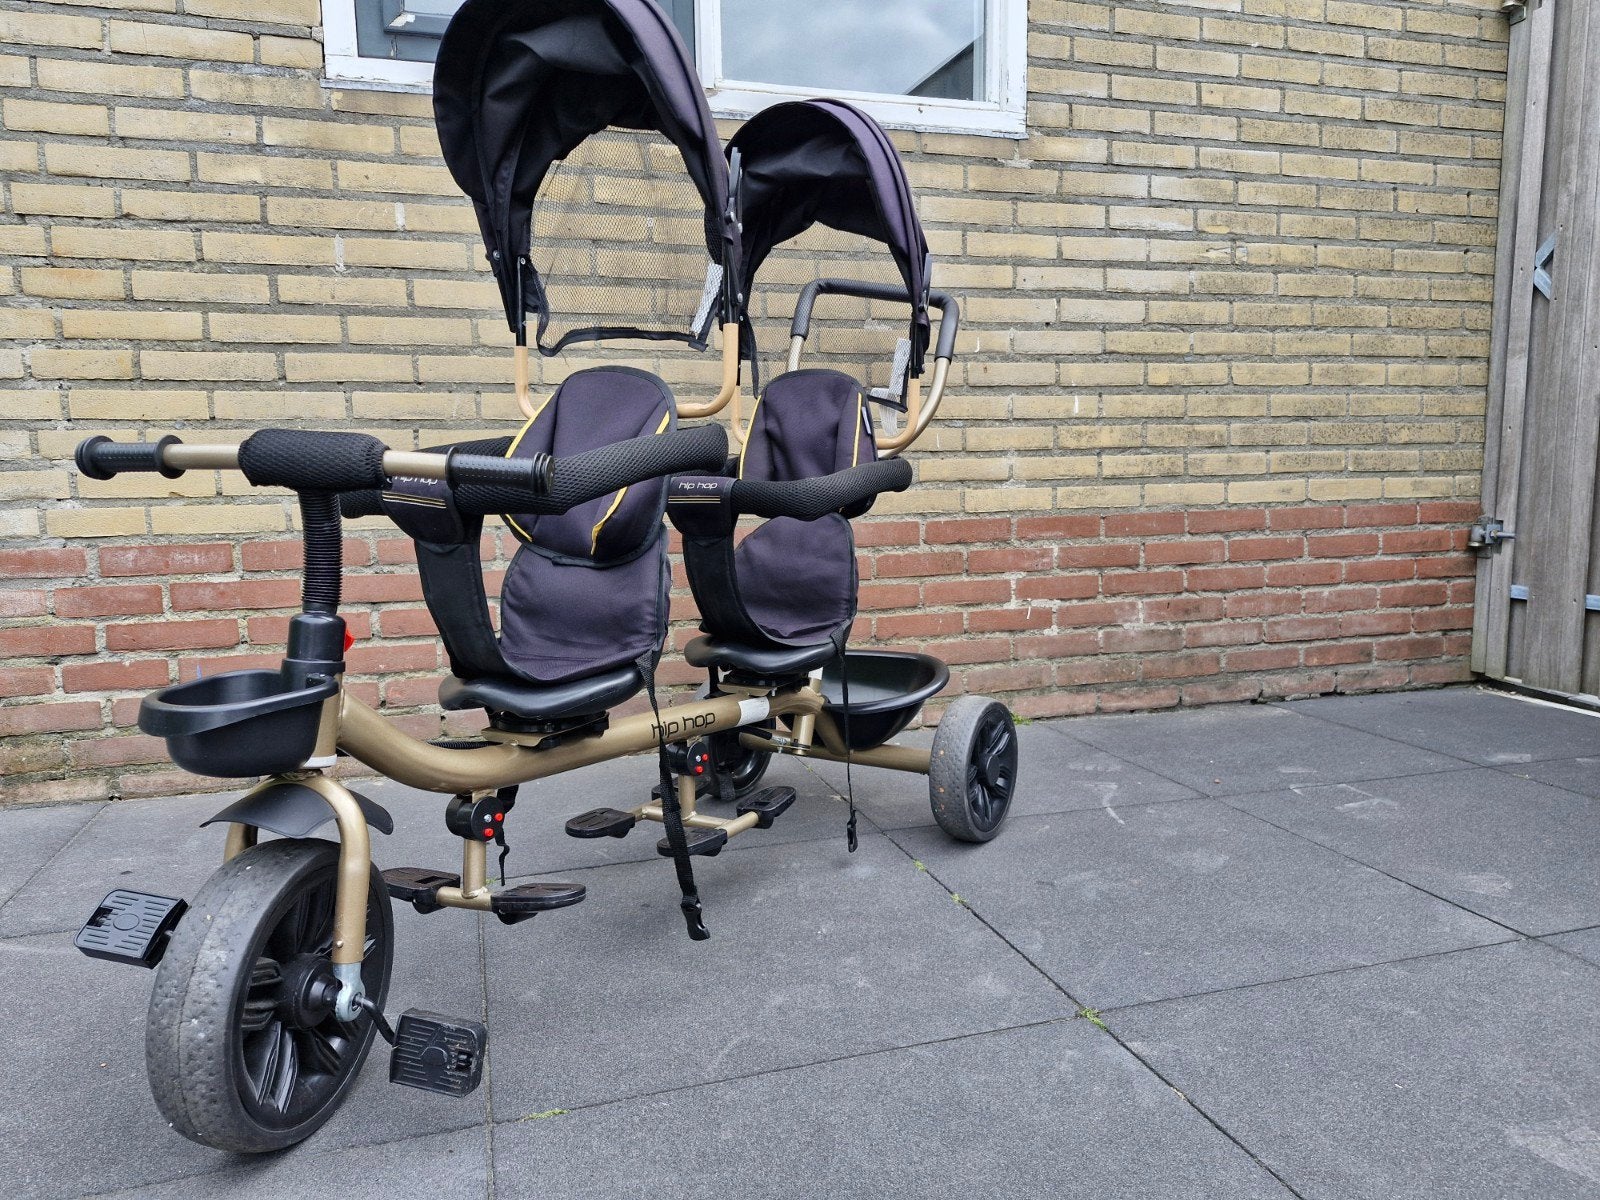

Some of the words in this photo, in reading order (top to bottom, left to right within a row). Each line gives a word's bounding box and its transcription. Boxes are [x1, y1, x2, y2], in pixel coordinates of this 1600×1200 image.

[678, 482, 695, 490] hip
[697, 482, 718, 490] hop
[651, 720, 679, 739] hip
[682, 712, 716, 731] hop
